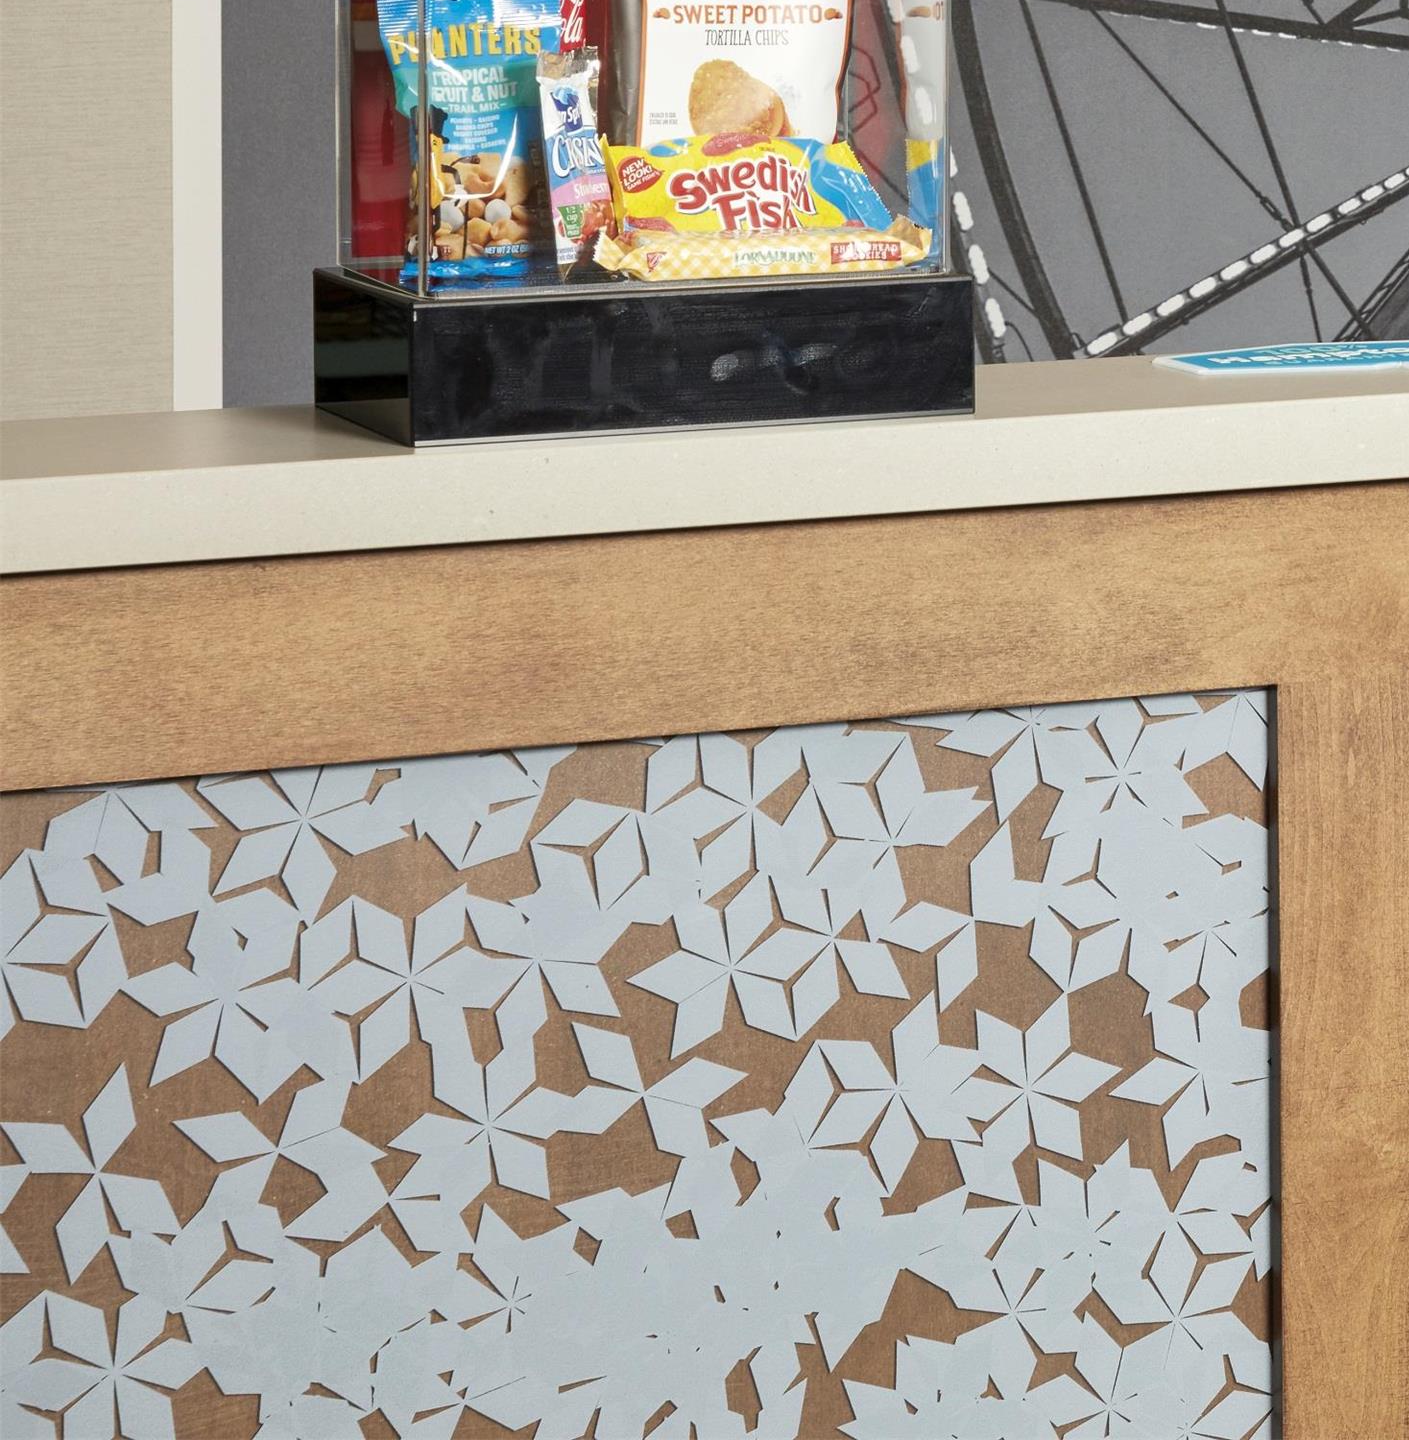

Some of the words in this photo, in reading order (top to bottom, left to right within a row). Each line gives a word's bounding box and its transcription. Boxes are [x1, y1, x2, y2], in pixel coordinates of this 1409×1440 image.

[673, 5, 738, 24] SWEET
[742, 4, 823, 24] POTATO
[705, 29, 751, 46] TORTILLA
[755, 29, 790, 46] CHIPS
[472, 85, 485, 102] &
[487, 82, 518, 100] NUT
[449, 104, 475, 114] TRAIL
[479, 102, 500, 111] MIX
[622, 158, 644, 177] NEW
[623, 165, 653, 187] LOOK!
[669, 155, 814, 212] Swedish
[714, 193, 799, 230] Fish
